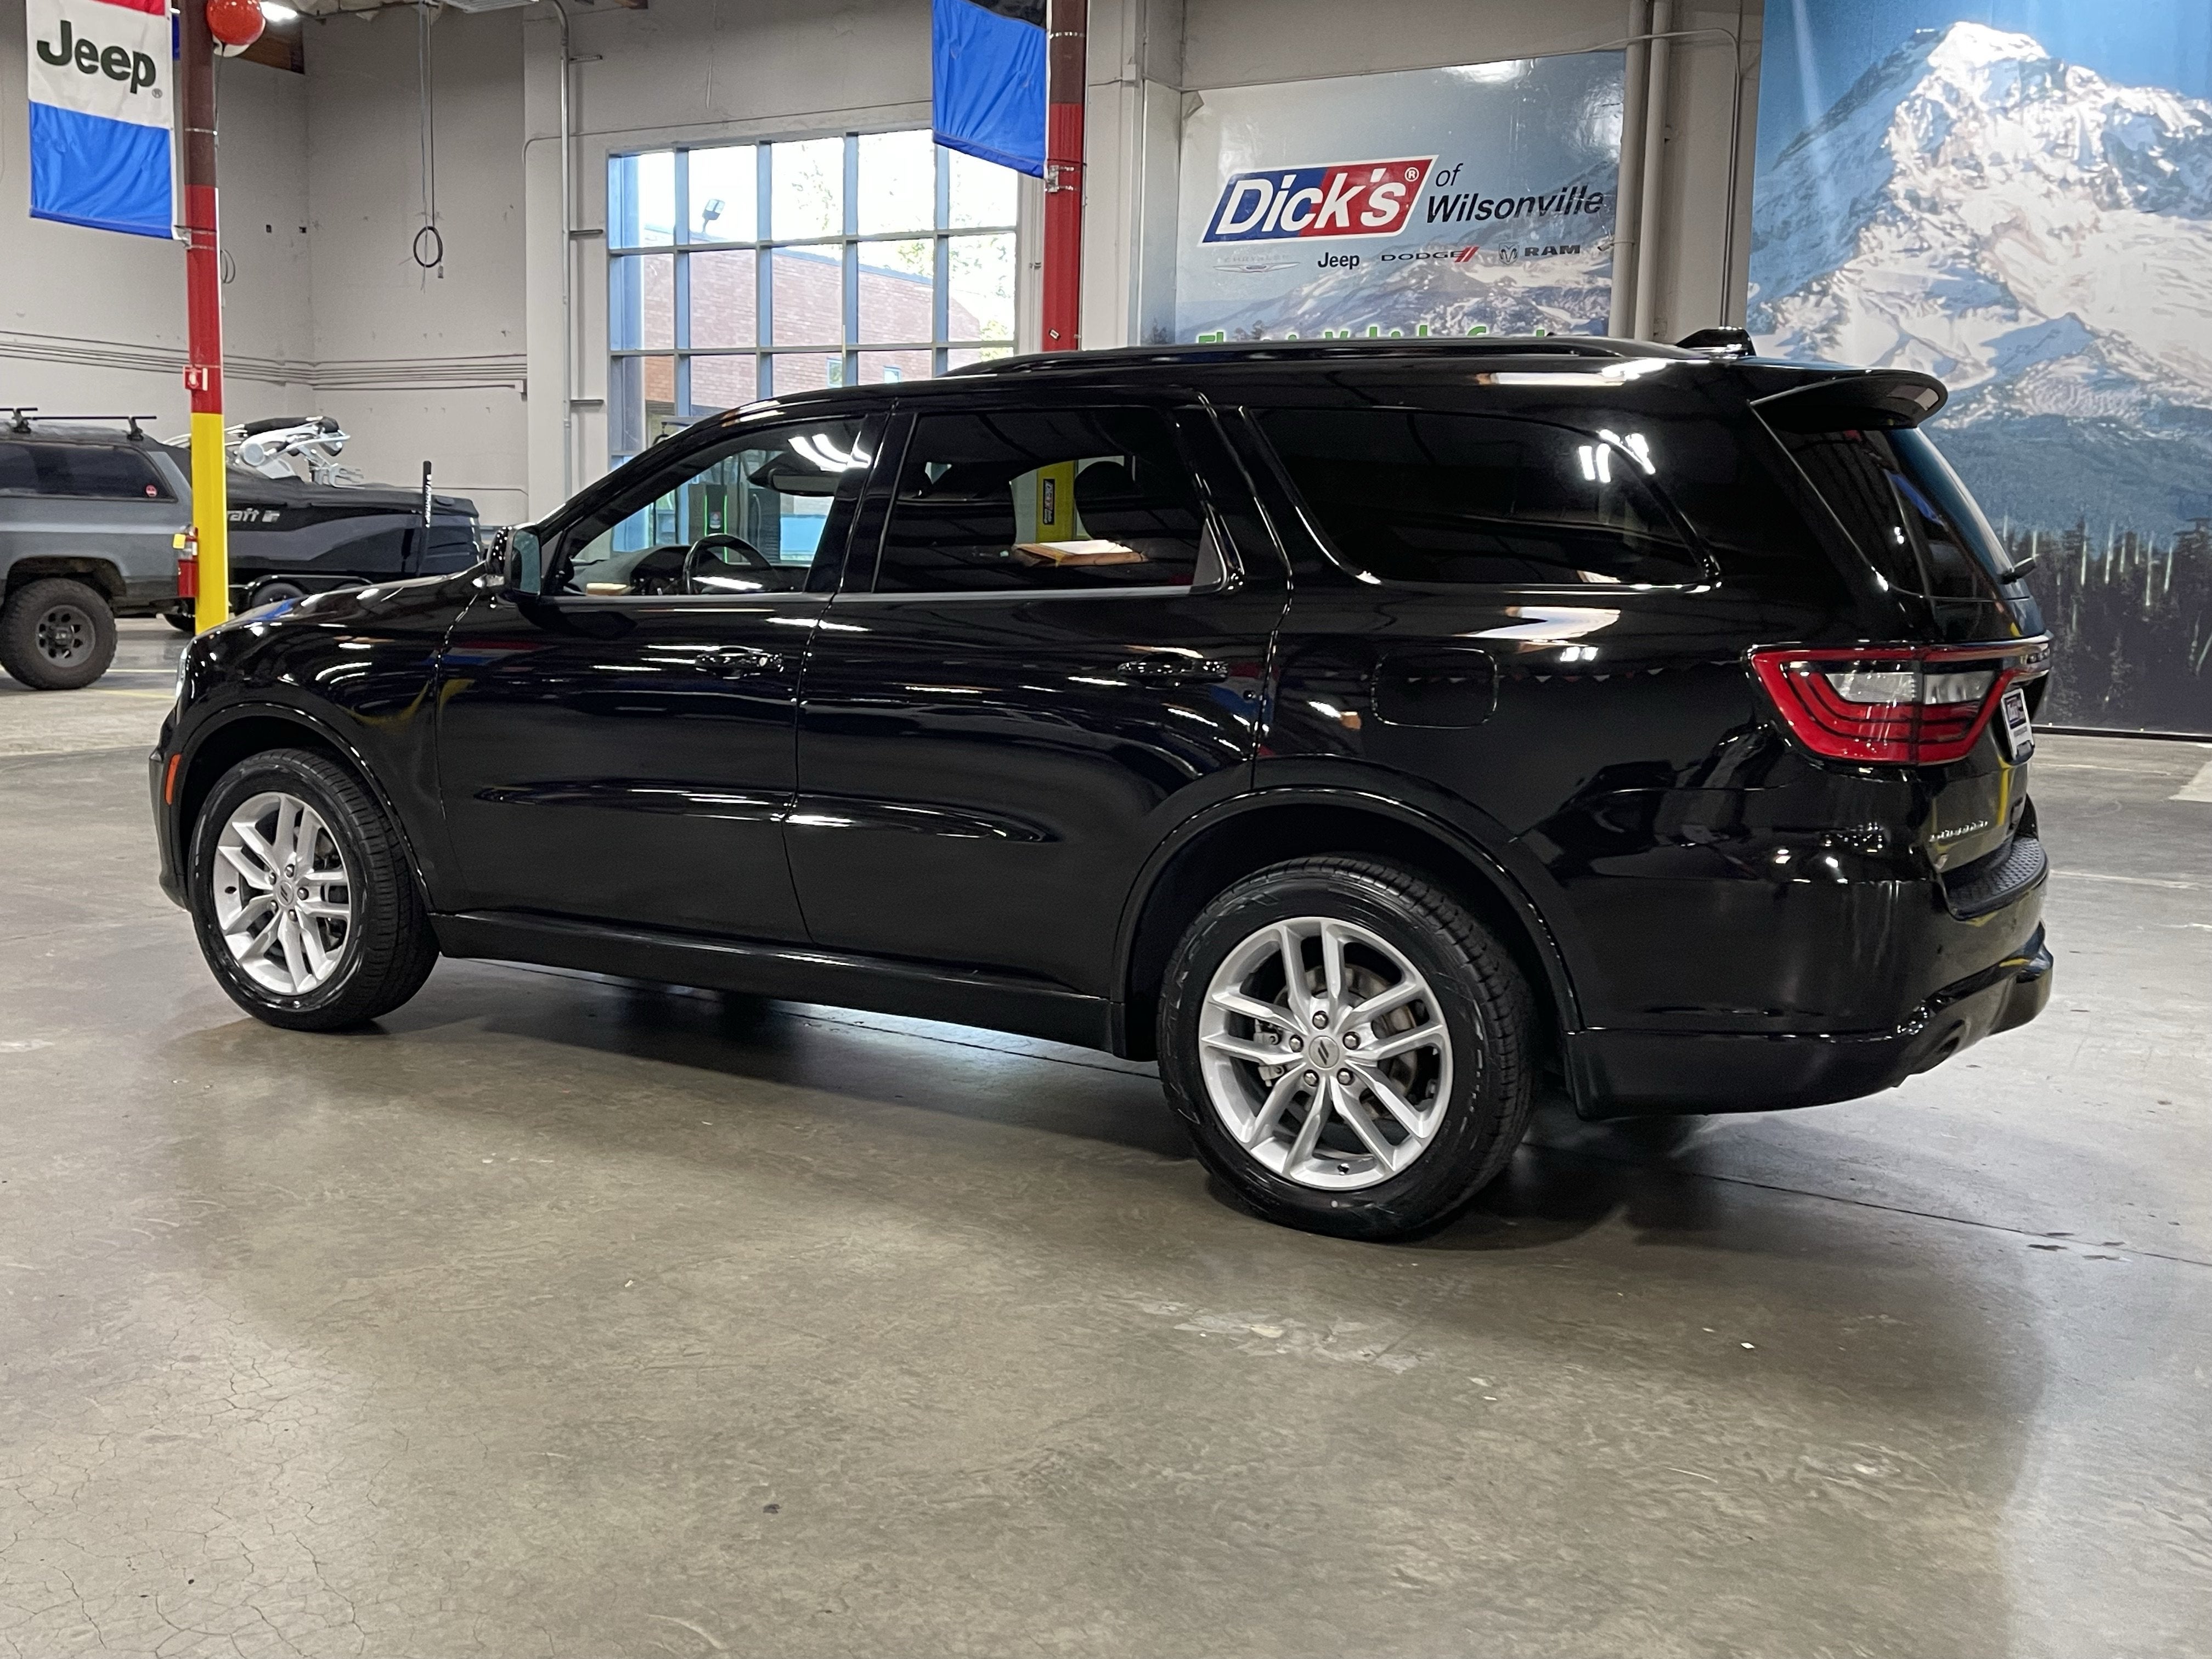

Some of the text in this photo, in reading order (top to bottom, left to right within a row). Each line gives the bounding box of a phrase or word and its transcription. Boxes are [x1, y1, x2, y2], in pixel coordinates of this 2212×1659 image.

[36, 20, 156, 94] Jeep
[1435, 163, 1464, 187] of
[1215, 168, 1407, 235] Dick's
[1426, 184, 1604, 223] Wilsonville
[1317, 252, 1360, 269] Jeep
[1381, 251, 1465, 262] DODGE
[1525, 244, 1581, 257] RAM
